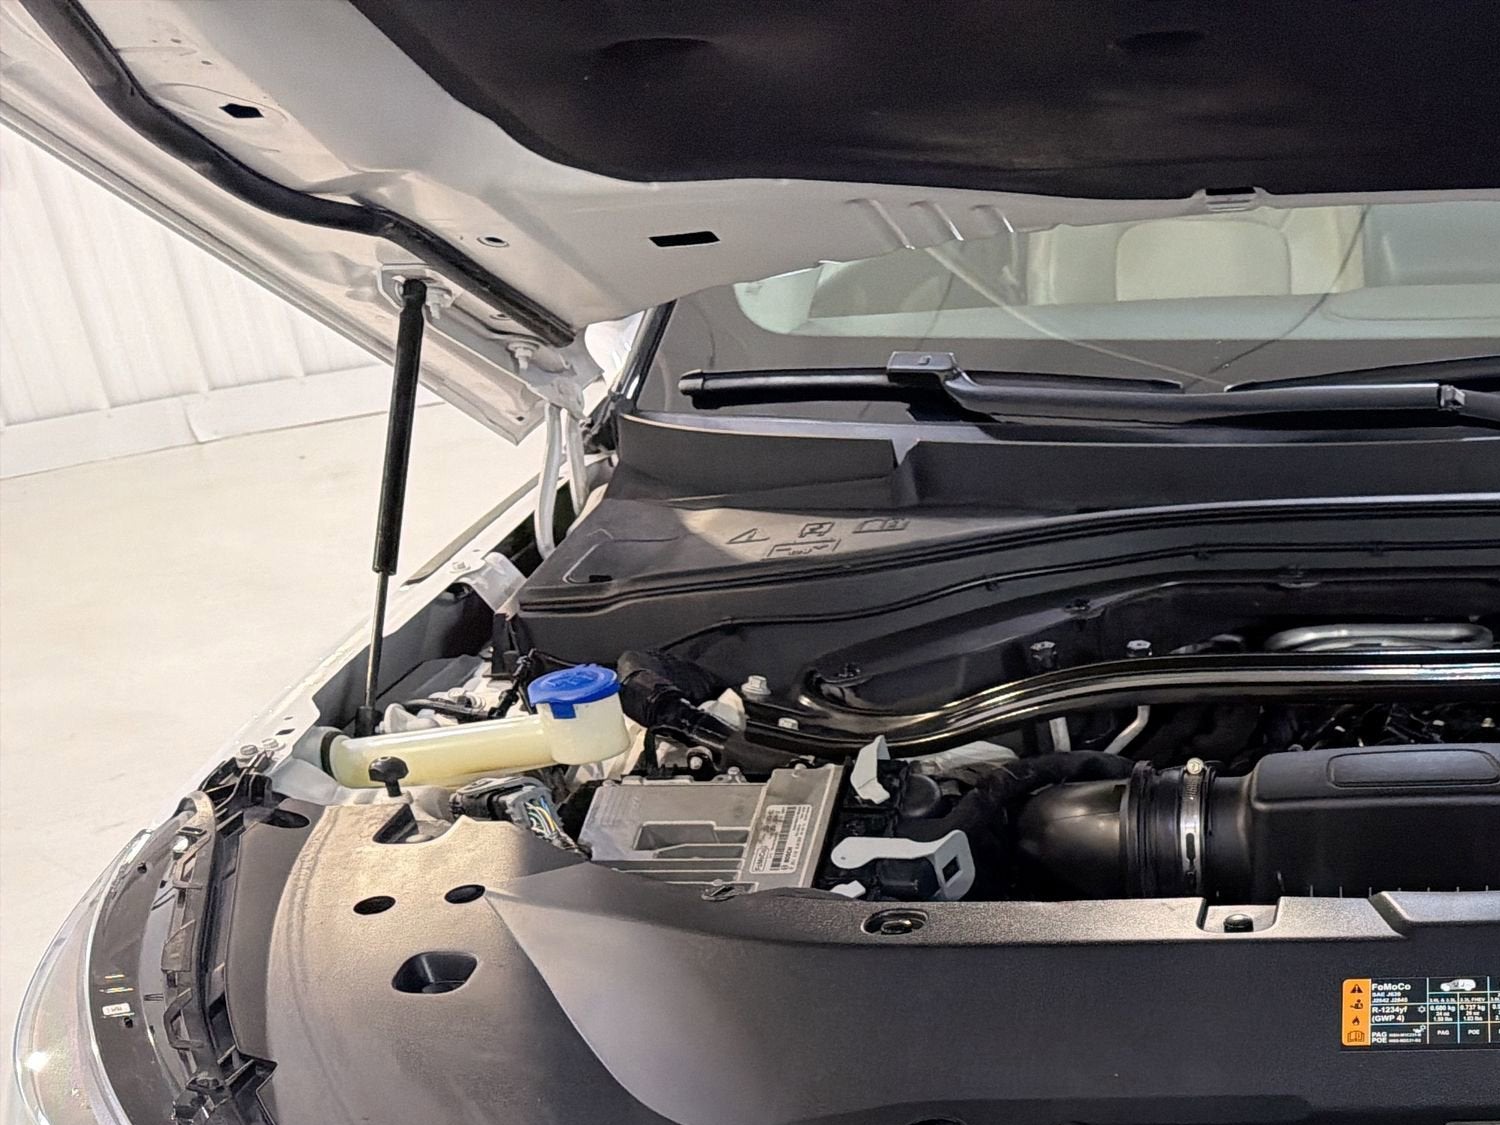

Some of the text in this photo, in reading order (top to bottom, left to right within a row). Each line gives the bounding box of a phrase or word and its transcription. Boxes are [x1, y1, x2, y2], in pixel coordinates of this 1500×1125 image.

[1372, 982, 1412, 990] FoMoCo
[1372, 1006, 1408, 1014] R-1234yf
[1372, 1015, 1405, 1023] (GWP 4)
